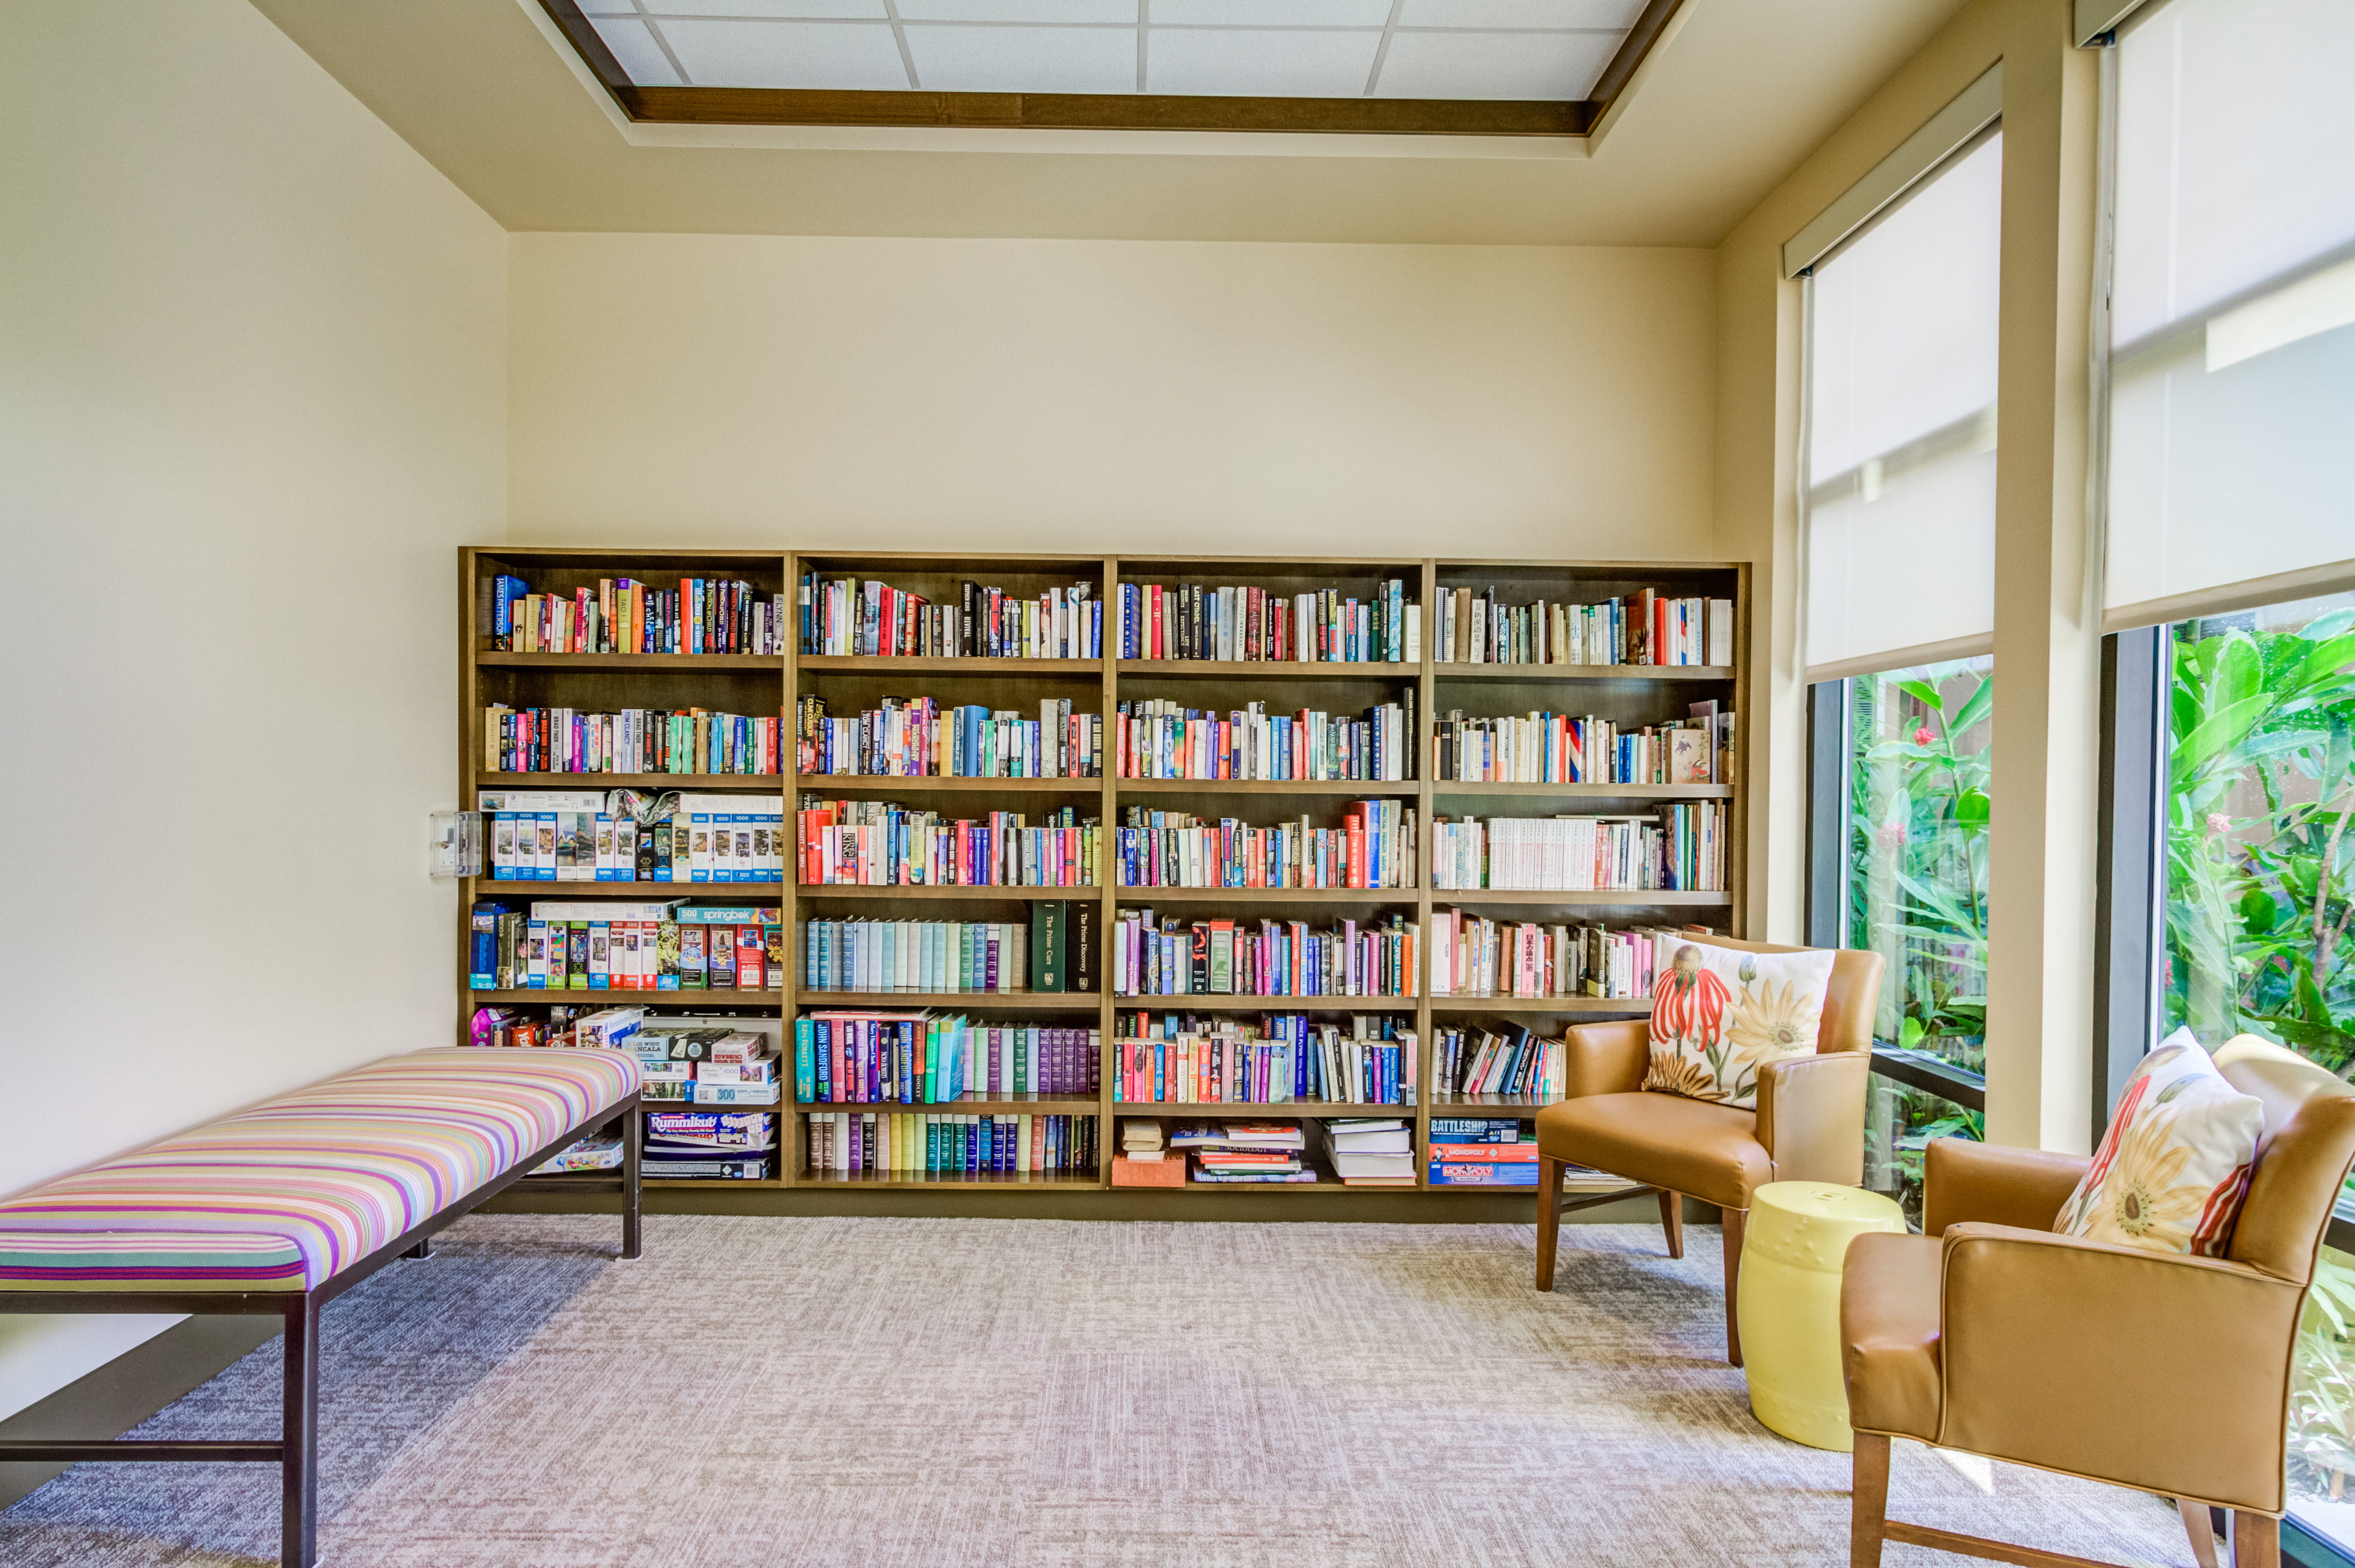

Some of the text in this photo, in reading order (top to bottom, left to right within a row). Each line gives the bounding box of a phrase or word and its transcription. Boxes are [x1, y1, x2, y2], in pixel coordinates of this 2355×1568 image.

[704, 910, 749, 921] springbok
[818, 1024, 828, 1080] JOHN SANDFORD
[833, 1028, 842, 1068] DIANA PALMER
[1408, 1062, 1417, 1085] CONNELLY
[718, 1089, 734, 1100] 300
[651, 1116, 717, 1133] Rummikub
[1431, 1120, 1488, 1132] BATTLESHIP
